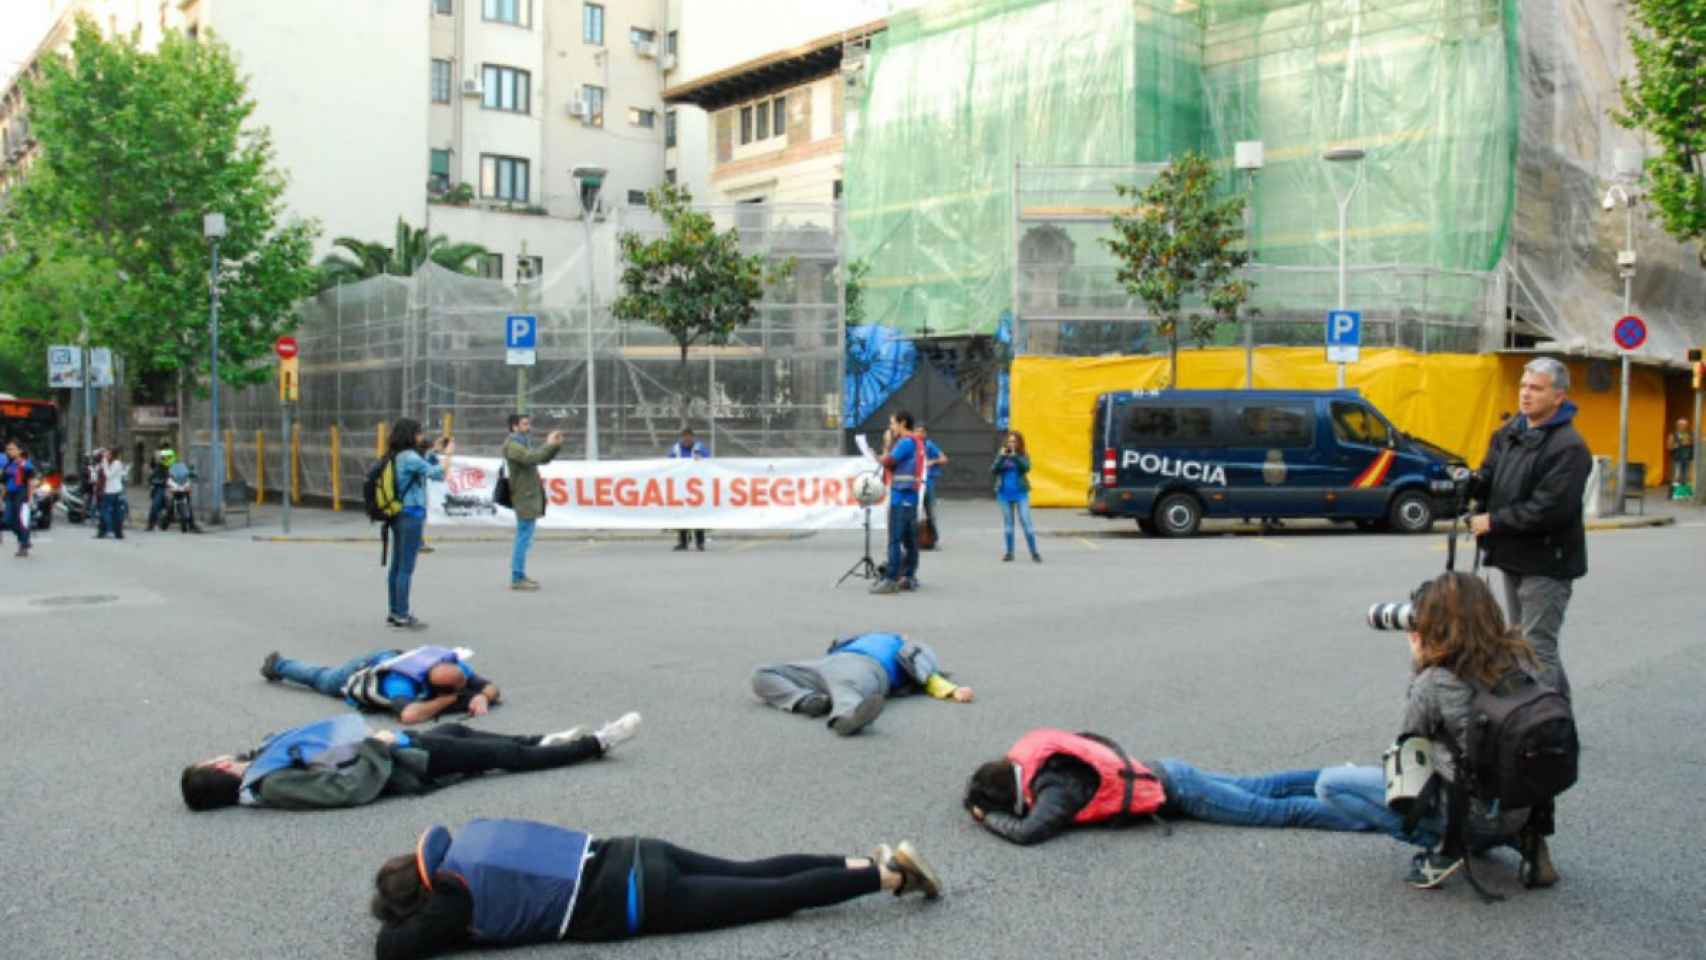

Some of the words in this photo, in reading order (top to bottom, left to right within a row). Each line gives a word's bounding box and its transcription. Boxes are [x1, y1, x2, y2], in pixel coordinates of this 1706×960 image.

[512, 319, 530, 345] P
[1334, 315, 1353, 340] P
[1122, 449, 1227, 487] POLICIA
[575, 477, 704, 506] LEGALS
[712, 477, 721, 507] I
[729, 477, 887, 507] SEGUR
